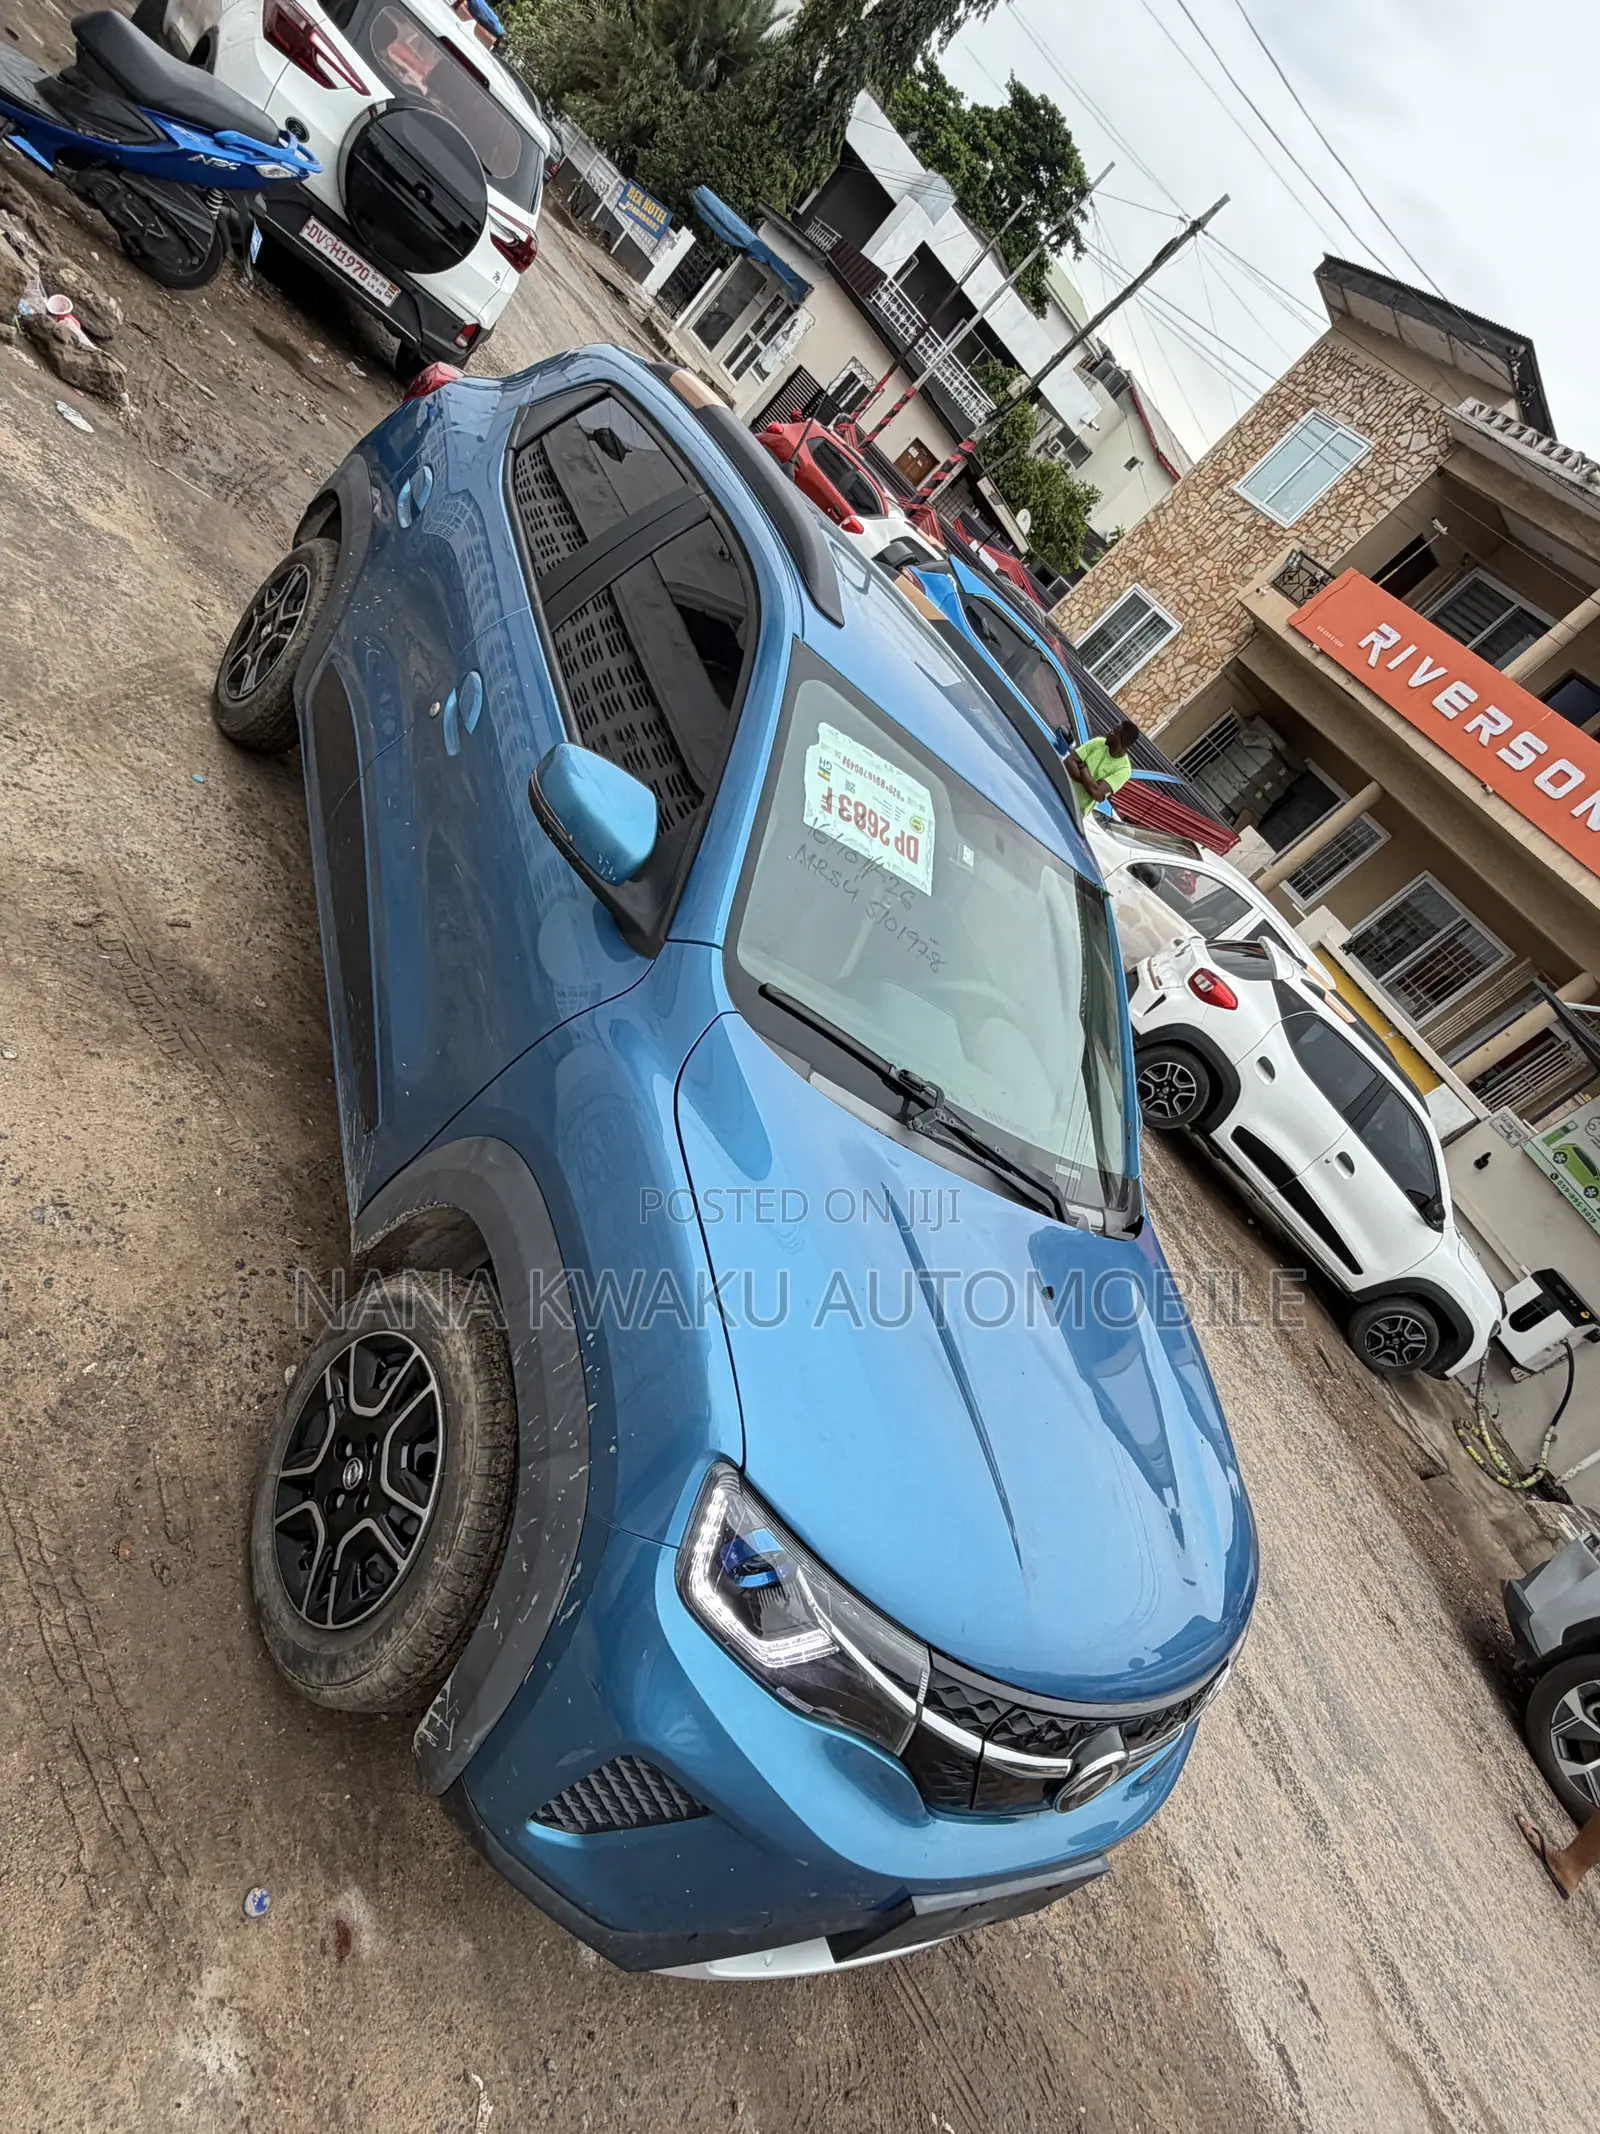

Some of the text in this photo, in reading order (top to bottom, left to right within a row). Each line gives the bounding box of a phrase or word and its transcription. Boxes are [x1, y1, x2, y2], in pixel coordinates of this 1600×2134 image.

[643, 198, 667, 224] HOTEL
[307, 224, 370, 281] DV H1970
[819, 757, 833, 771] GH
[837, 793, 891, 847] 2683
[894, 829, 919, 865] DP
